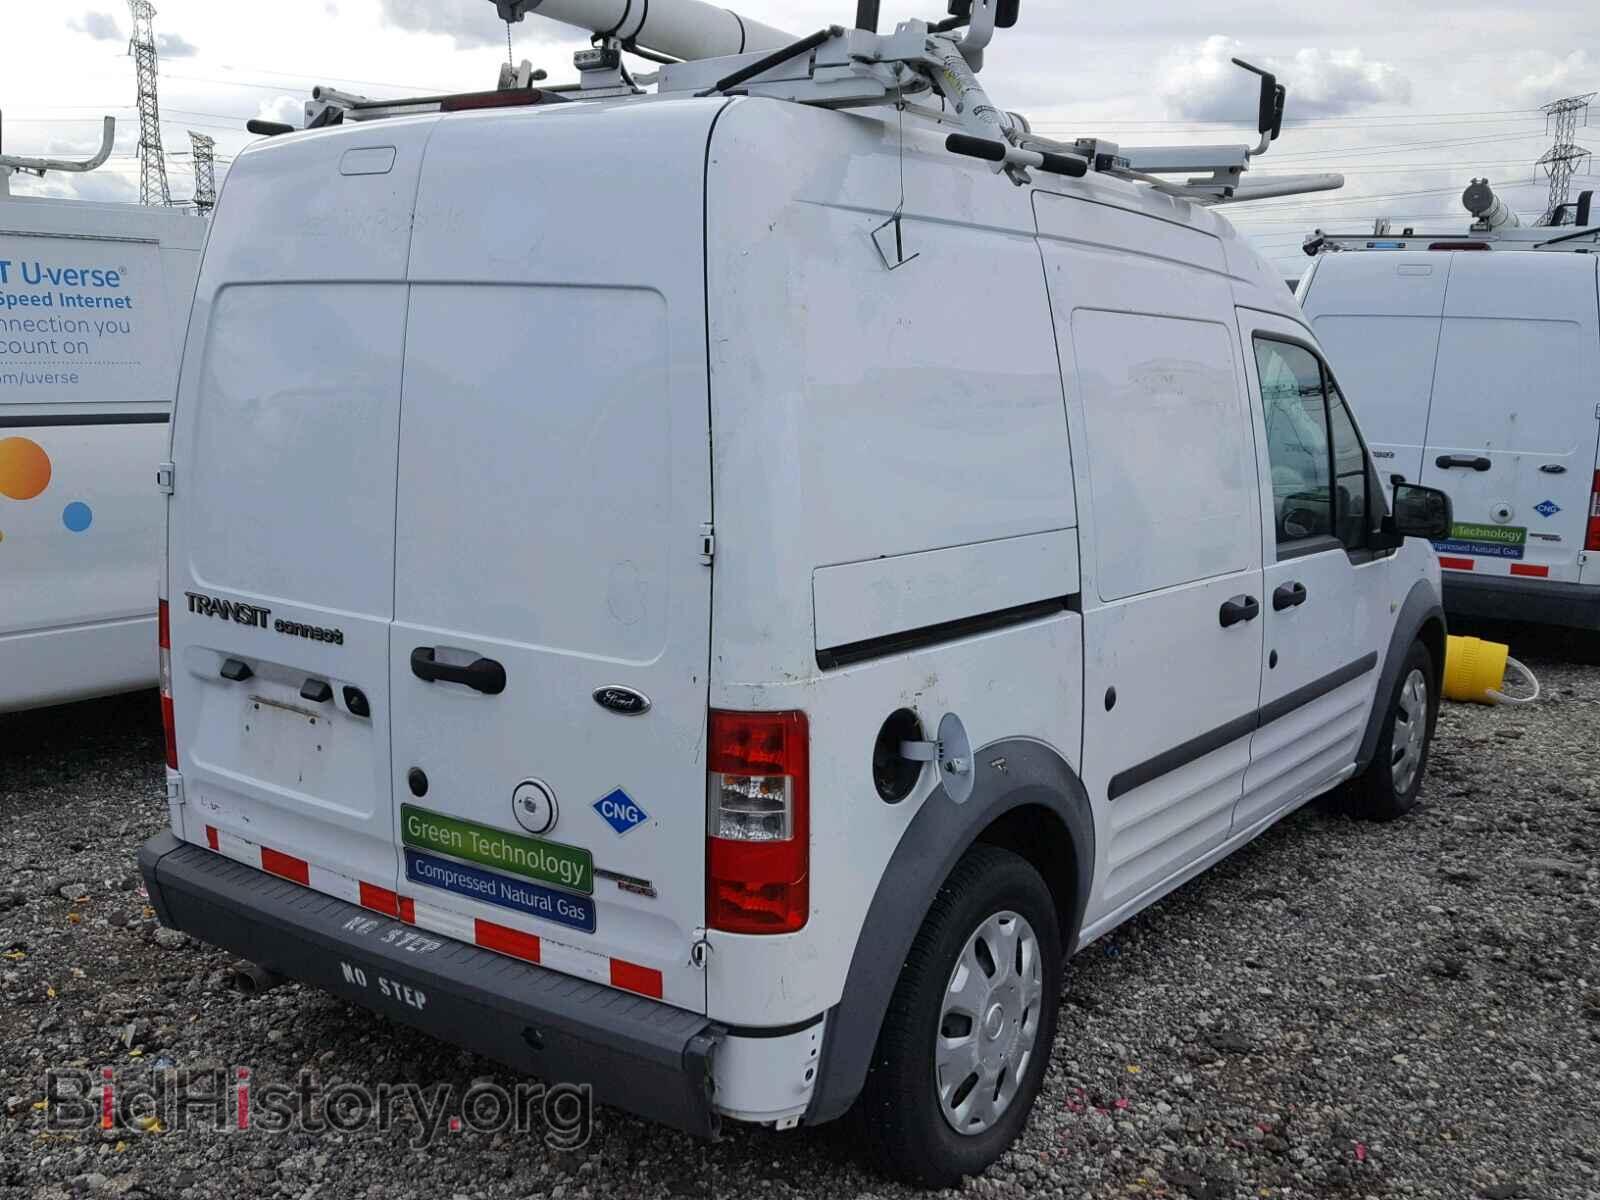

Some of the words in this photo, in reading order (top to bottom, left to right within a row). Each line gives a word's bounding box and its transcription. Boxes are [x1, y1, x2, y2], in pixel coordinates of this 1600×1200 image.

[59, 292, 133, 309] Internet
[95, 321, 131, 337] you
[63, 340, 89, 354] on
[1458, 526, 1523, 542] Technology
[184, 591, 271, 629] TRANSIT
[601, 800, 639, 823] CNG
[408, 815, 463, 849] Green
[469, 831, 584, 886] Technology
[415, 859, 497, 896] Compressed
[500, 882, 553, 912] Natural
[557, 899, 586, 921] Gas
[341, 961, 367, 987] NO
[378, 976, 426, 1010] STEP
